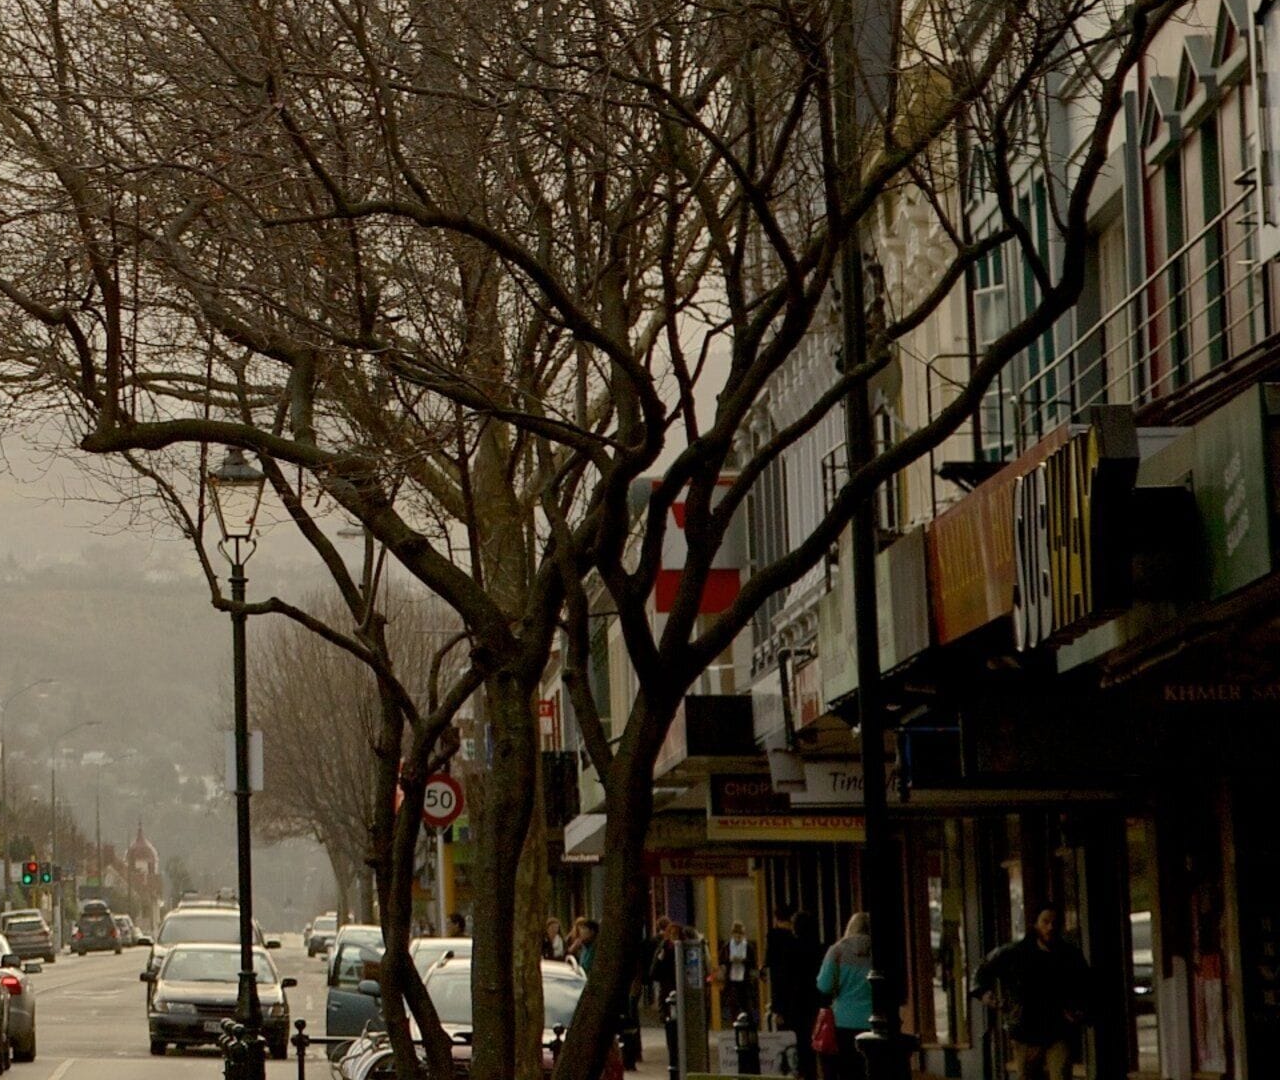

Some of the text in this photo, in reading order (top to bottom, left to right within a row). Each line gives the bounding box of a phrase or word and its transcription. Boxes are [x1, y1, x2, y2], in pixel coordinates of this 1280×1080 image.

[1013, 423, 1101, 652] SUBWAY
[1162, 683, 1242, 702] KHMER
[426, 789, 453, 809] 50
